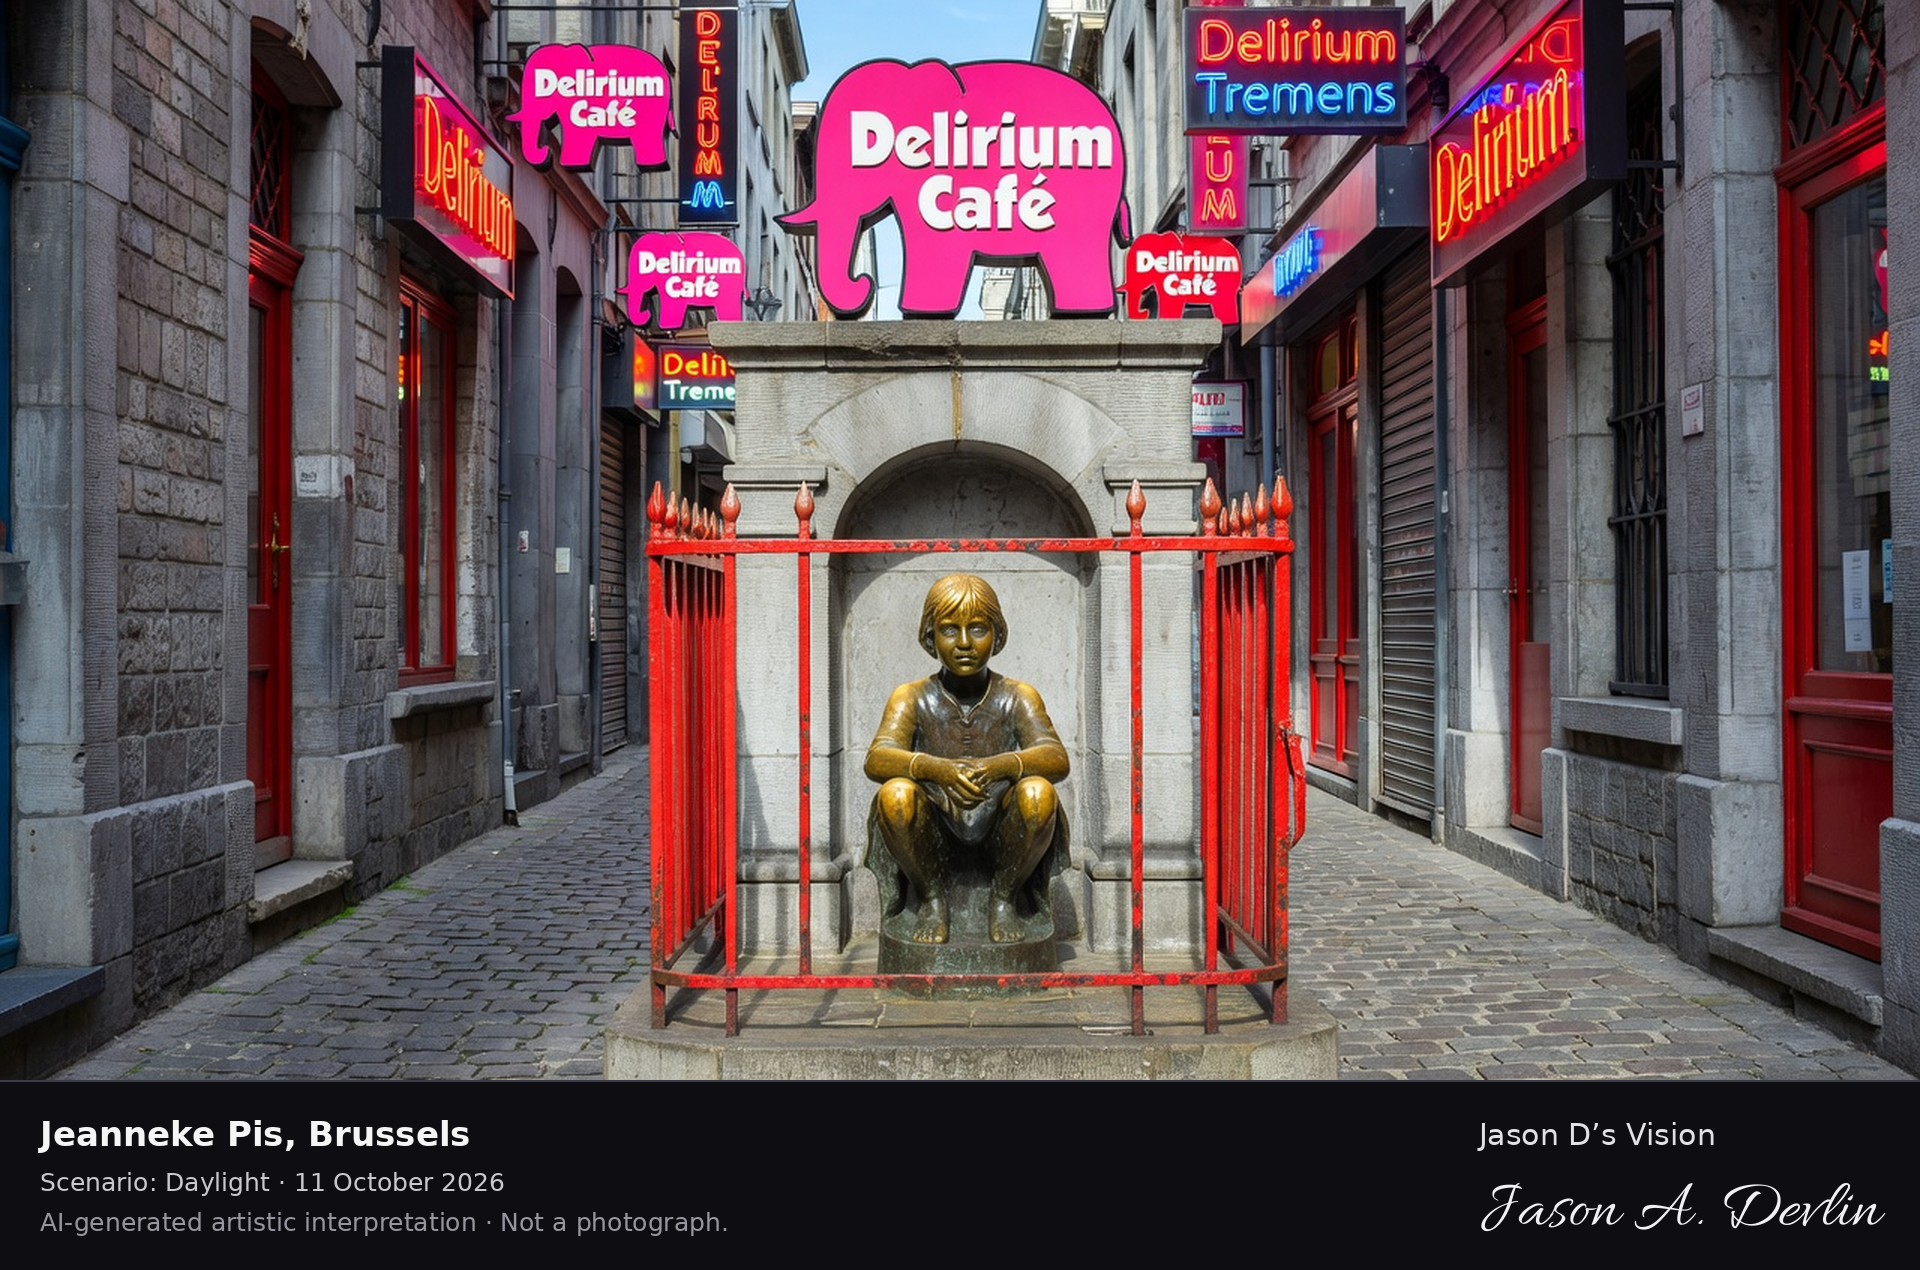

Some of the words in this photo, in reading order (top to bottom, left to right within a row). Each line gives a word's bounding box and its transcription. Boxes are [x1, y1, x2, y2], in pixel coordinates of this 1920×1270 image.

[1199, 18, 1397, 64] Delirium
[535, 69, 664, 98] Delirium
[1195, 72, 1397, 116] Tremens
[570, 99, 637, 128] Café
[850, 110, 1113, 168] Delirium
[1436, 67, 1572, 243] Delirium
[424, 95, 514, 261] Delirium
[918, 172, 1057, 231] Café
[638, 250, 742, 275] Delirium
[1136, 250, 1240, 273] Delirium
[664, 275, 720, 299] Café
[1163, 272, 1218, 297] Café
